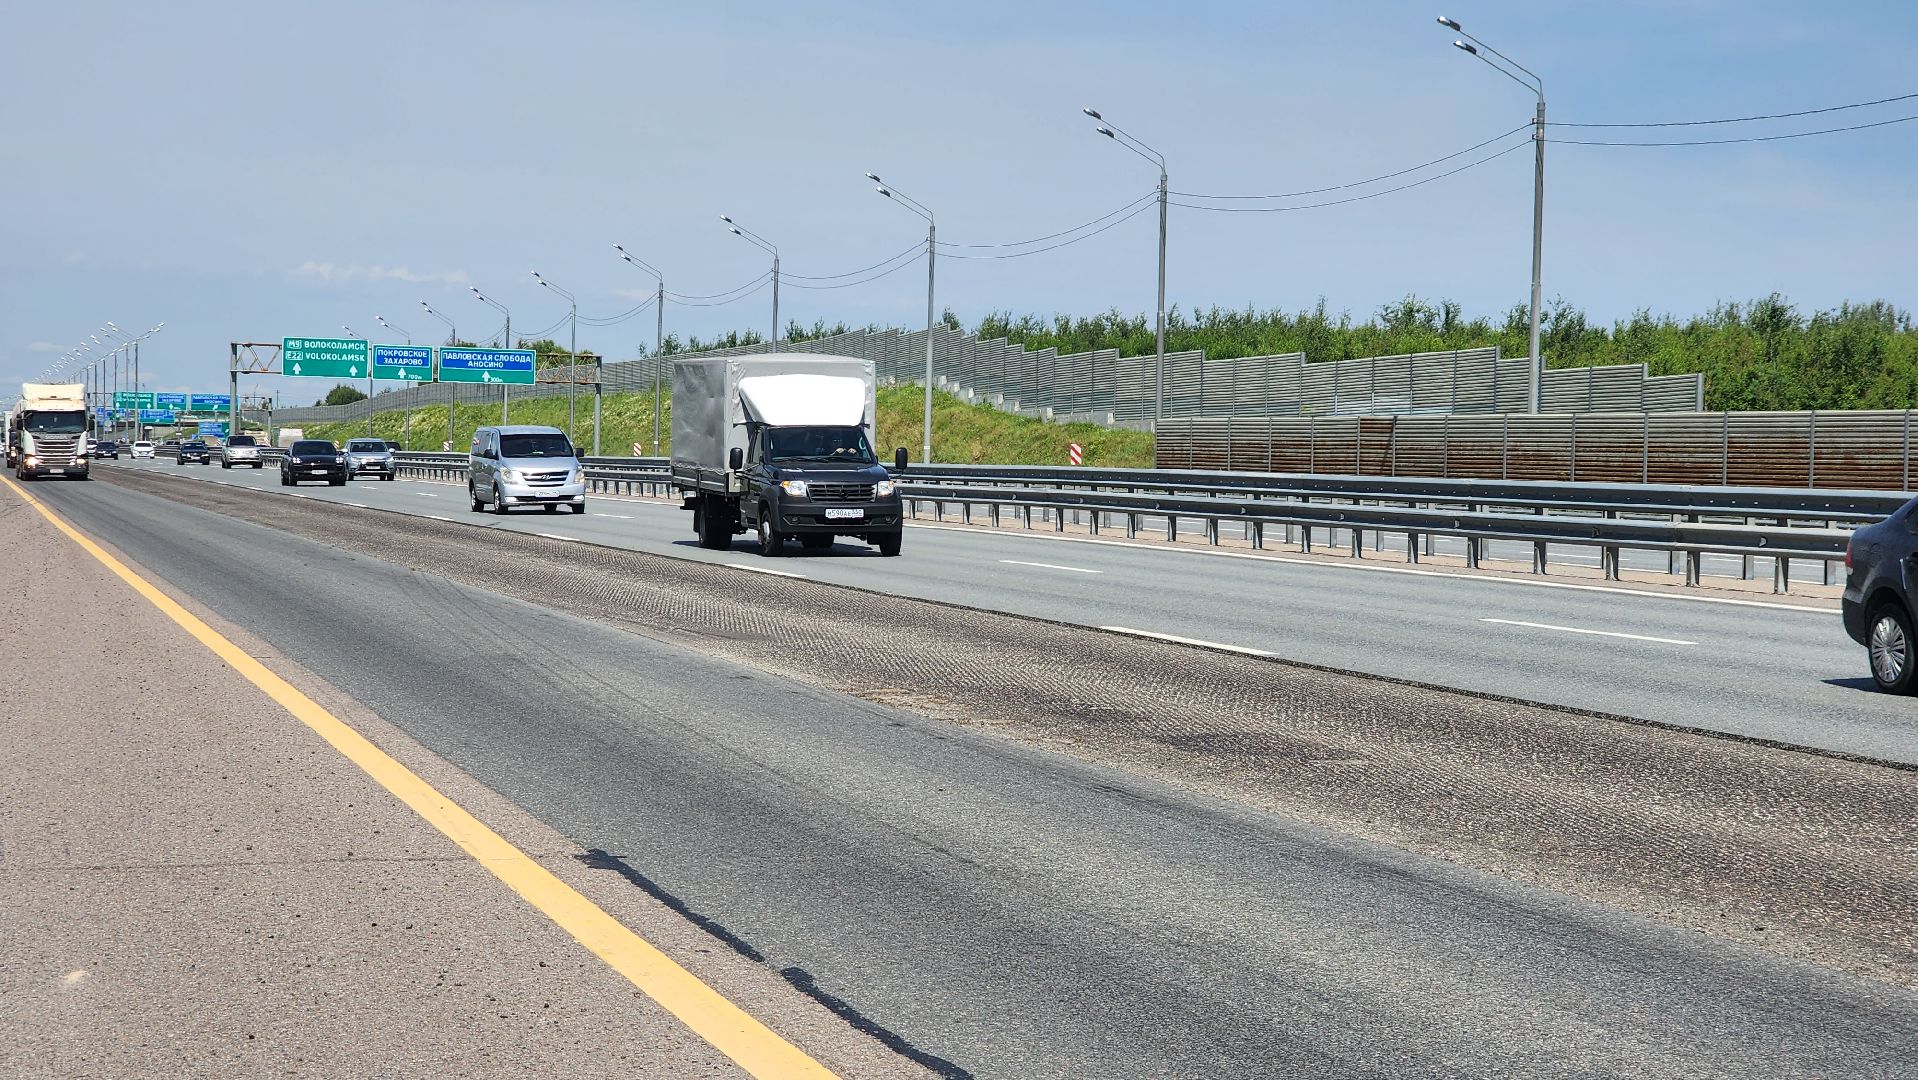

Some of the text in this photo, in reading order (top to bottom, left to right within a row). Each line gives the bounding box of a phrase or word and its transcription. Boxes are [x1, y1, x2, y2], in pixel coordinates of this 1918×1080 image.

[288, 340, 366, 350] М9 ВОЛОКОЛАМСК
[287, 351, 366, 362] E22 VOLOKOLAMSK
[378, 349, 427, 358] ПОКРОВСКОЕ
[443, 352, 531, 363] ПАВЛОВСКАЯ СЛОБОДА
[384, 357, 423, 366] ЗАХАРОВО
